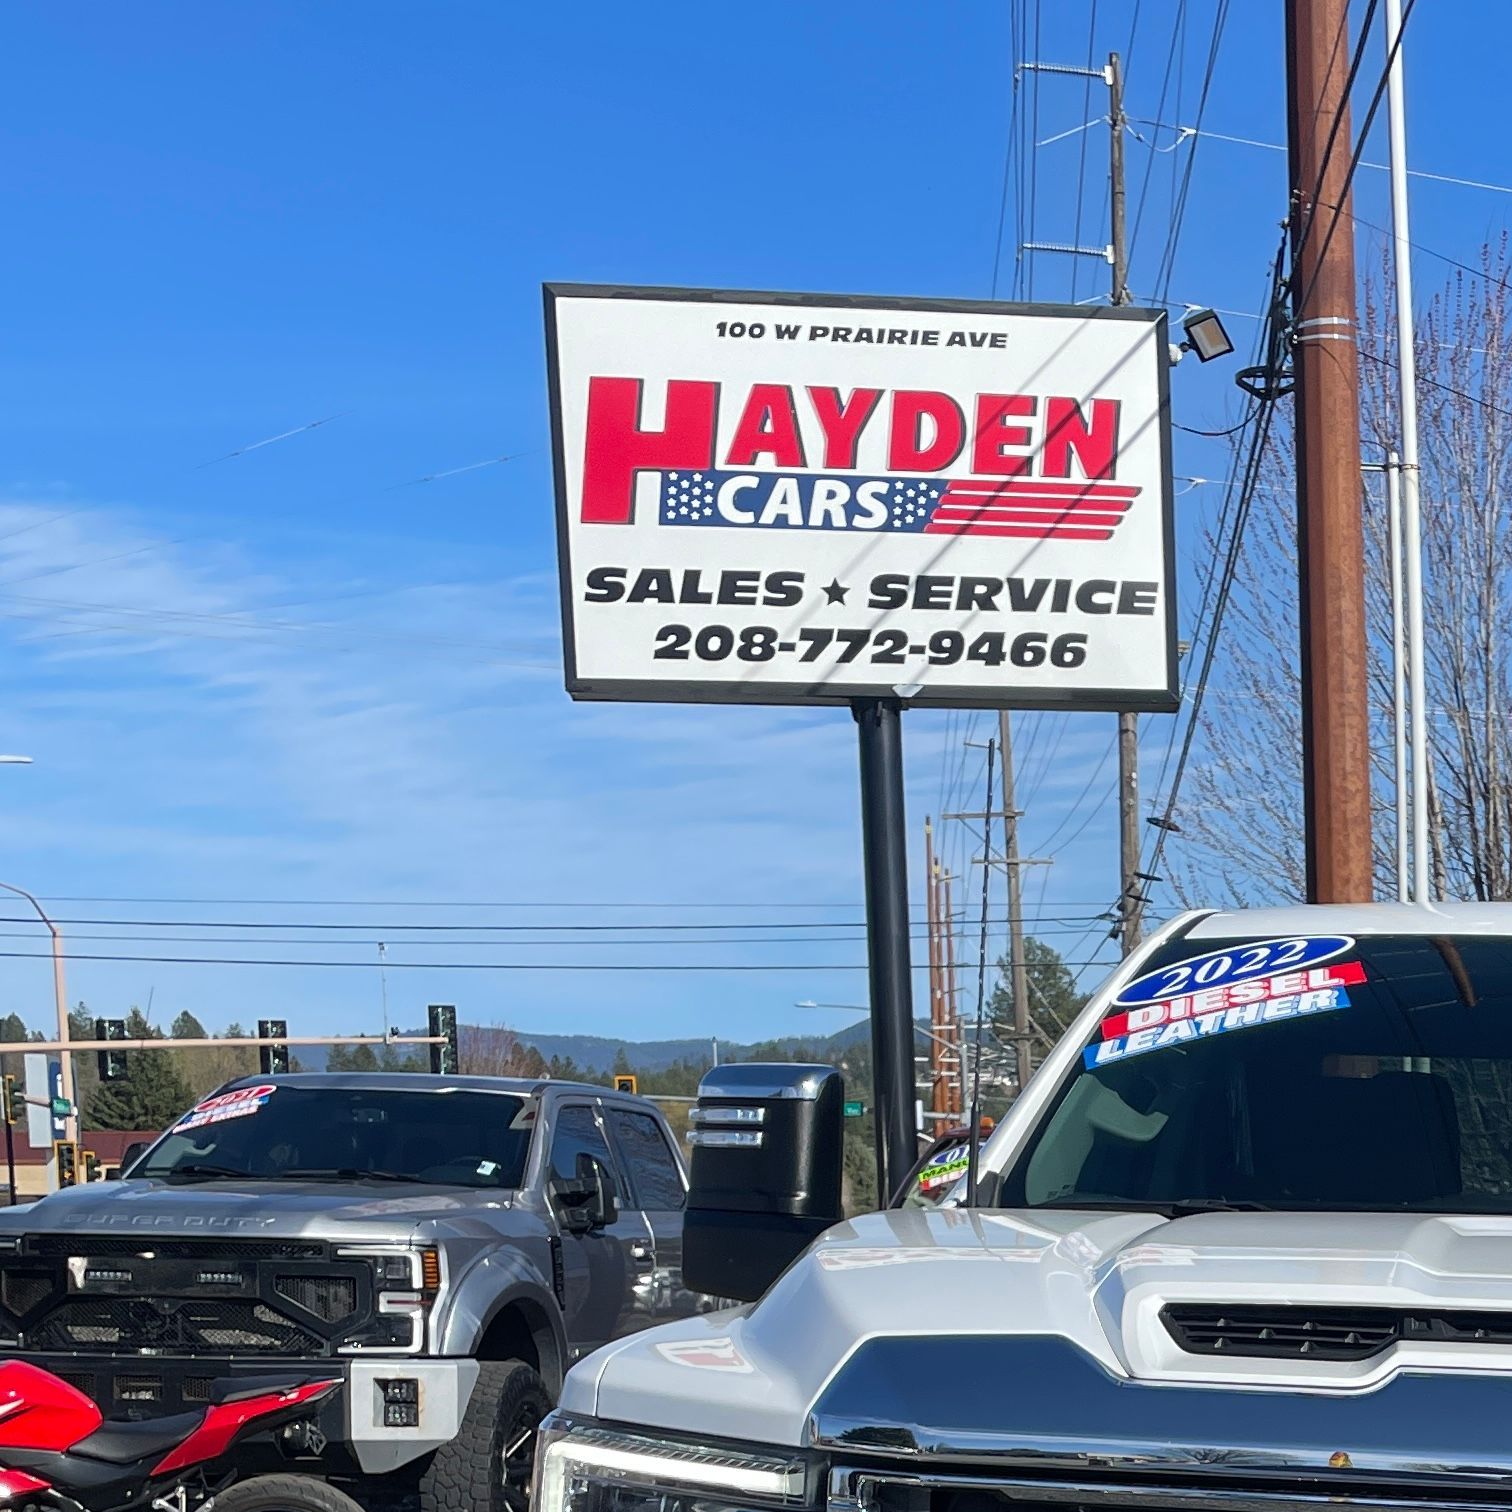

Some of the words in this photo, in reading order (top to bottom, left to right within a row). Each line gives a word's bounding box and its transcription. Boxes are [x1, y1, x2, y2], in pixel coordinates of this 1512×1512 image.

[716, 321, 764, 341] 100
[774, 323, 802, 342] W
[809, 324, 940, 347] PRAIRIE
[946, 329, 1009, 349] AVE
[580, 375, 1122, 525] HAYDEN
[717, 474, 892, 530] CARS
[584, 567, 805, 607] SALES
[867, 573, 1159, 616] SERVICE
[653, 624, 1088, 669] 208-772-9466
[1152, 939, 1310, 998] 2022
[1094, 988, 1340, 1064] LEATHER
[1126, 967, 1344, 1032] DIESEL
[64, 1213, 176, 1226] SUPER
[184, 1216, 276, 1228] DUTY
